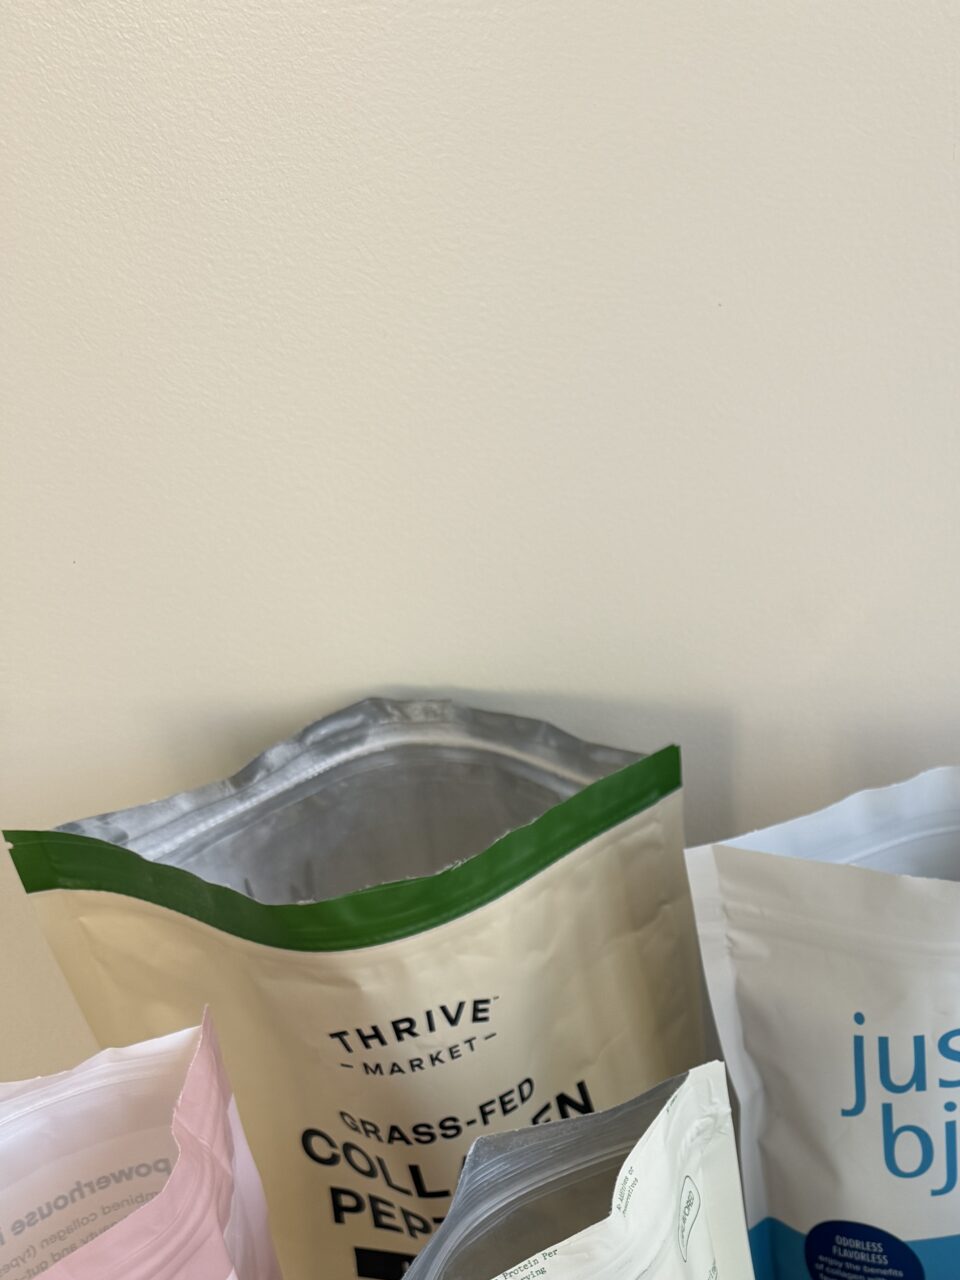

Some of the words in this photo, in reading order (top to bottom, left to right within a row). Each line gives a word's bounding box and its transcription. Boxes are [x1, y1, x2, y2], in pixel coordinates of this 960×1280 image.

[329, 998, 491, 1054] THRIVE
[363, 1036, 477, 1076] MARKET
[339, 1077, 535, 1146] GRASS-FED
[832, 1245, 888, 1266] FLAVORLESS
[834, 1234, 883, 1253] ODORLESS
[502, 1257, 539, 1280] Protein
[541, 1248, 559, 1261] Per
